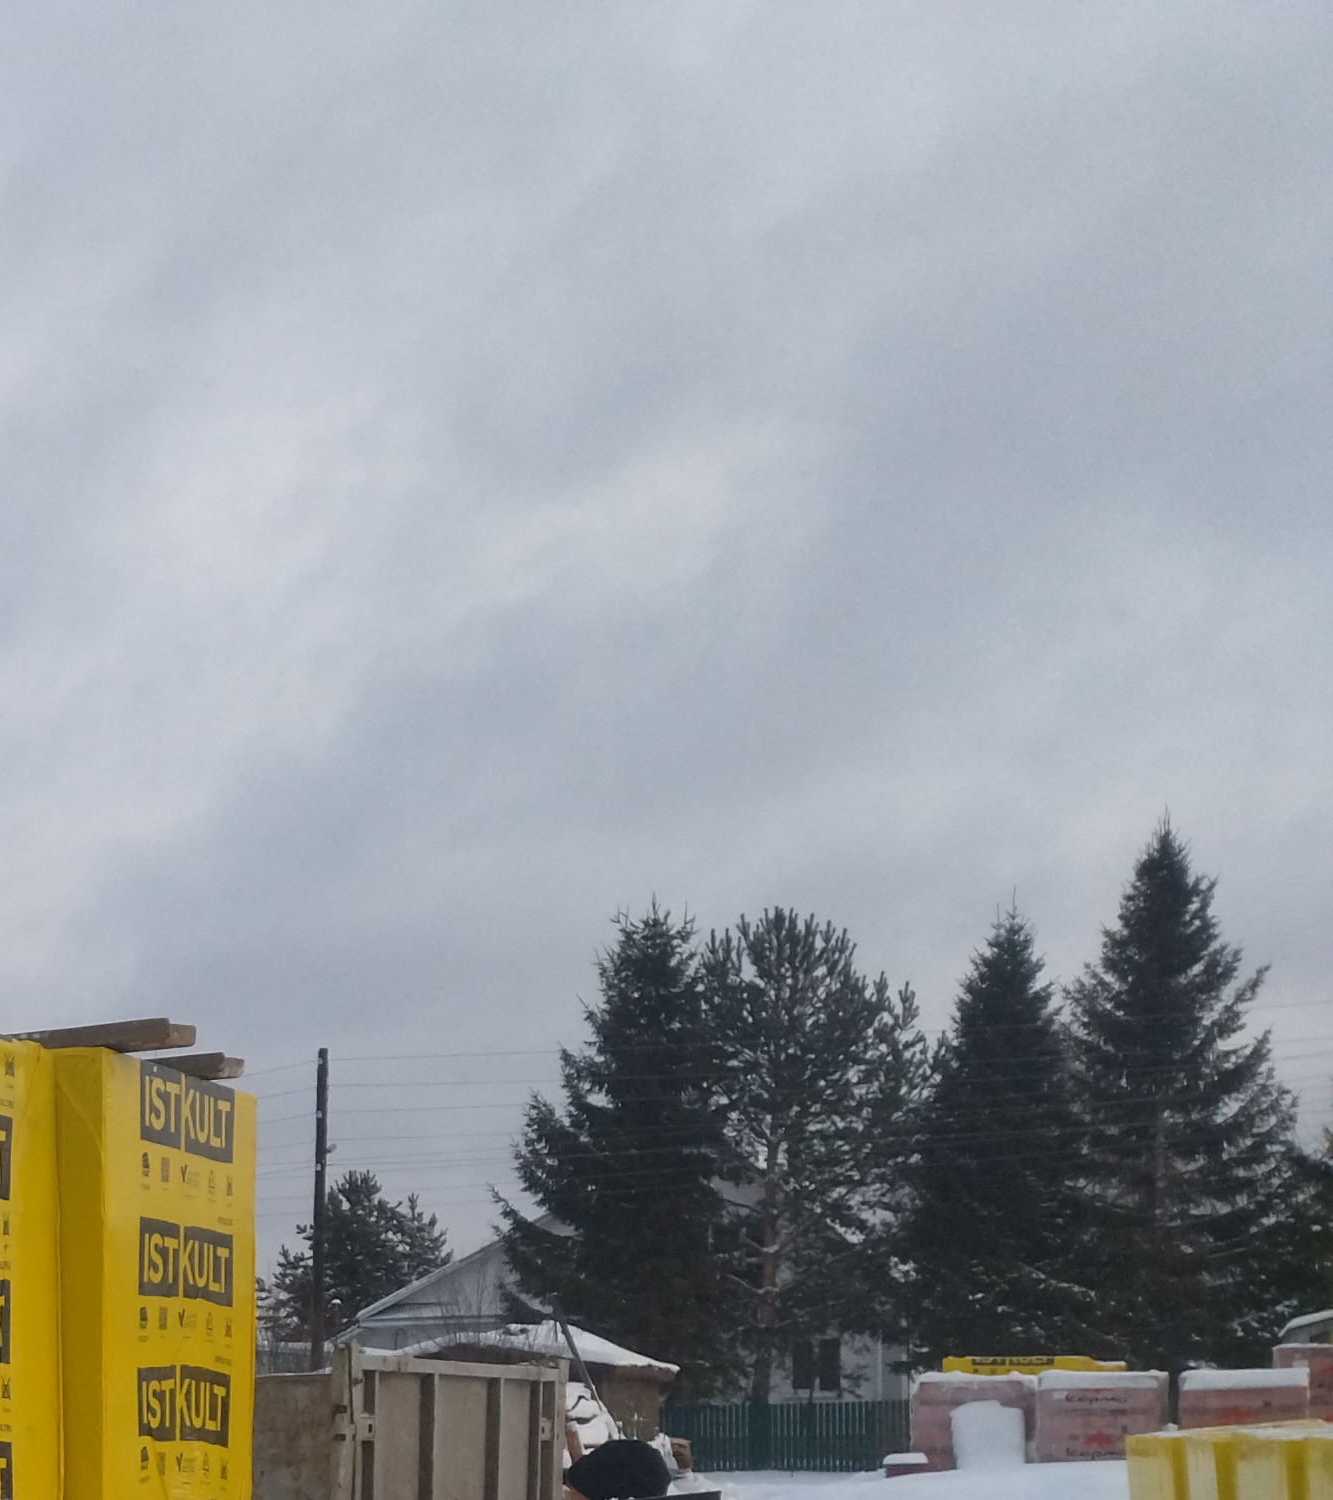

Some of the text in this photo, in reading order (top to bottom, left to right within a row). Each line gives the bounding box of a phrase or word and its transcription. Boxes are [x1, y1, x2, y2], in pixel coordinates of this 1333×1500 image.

[144, 1074, 232, 1149] ISTKULT
[143, 1232, 230, 1294] ISTKULT
[141, 1377, 227, 1432] ISTKULT
